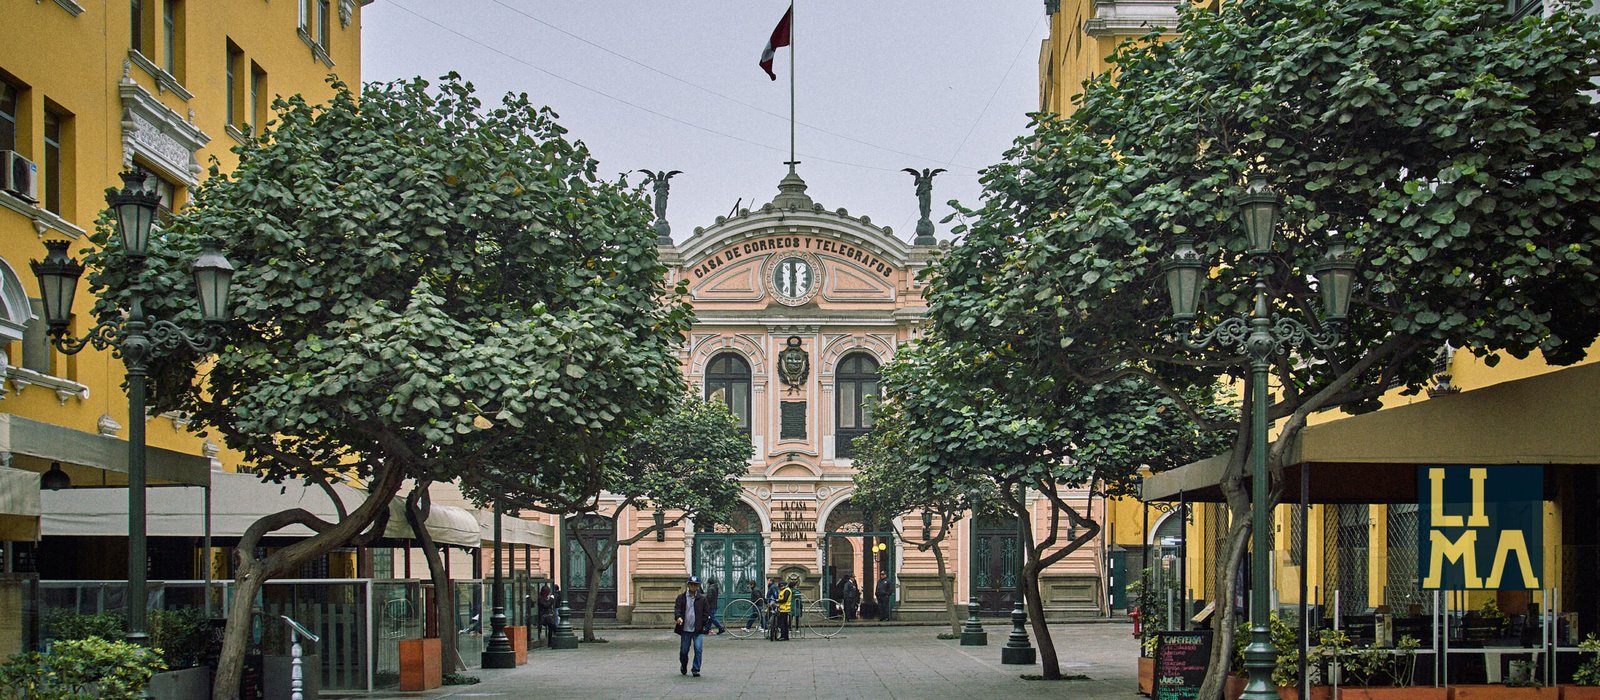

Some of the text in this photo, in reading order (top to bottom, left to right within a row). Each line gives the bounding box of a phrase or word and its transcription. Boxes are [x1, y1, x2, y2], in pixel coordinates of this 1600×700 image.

[694, 237, 893, 278] CASA DE CORREOS Y TELEGRAFOS
[781, 501, 807, 511] LA CASA
[784, 511, 803, 521] DE LA
[780, 531, 808, 541] PERUANA
